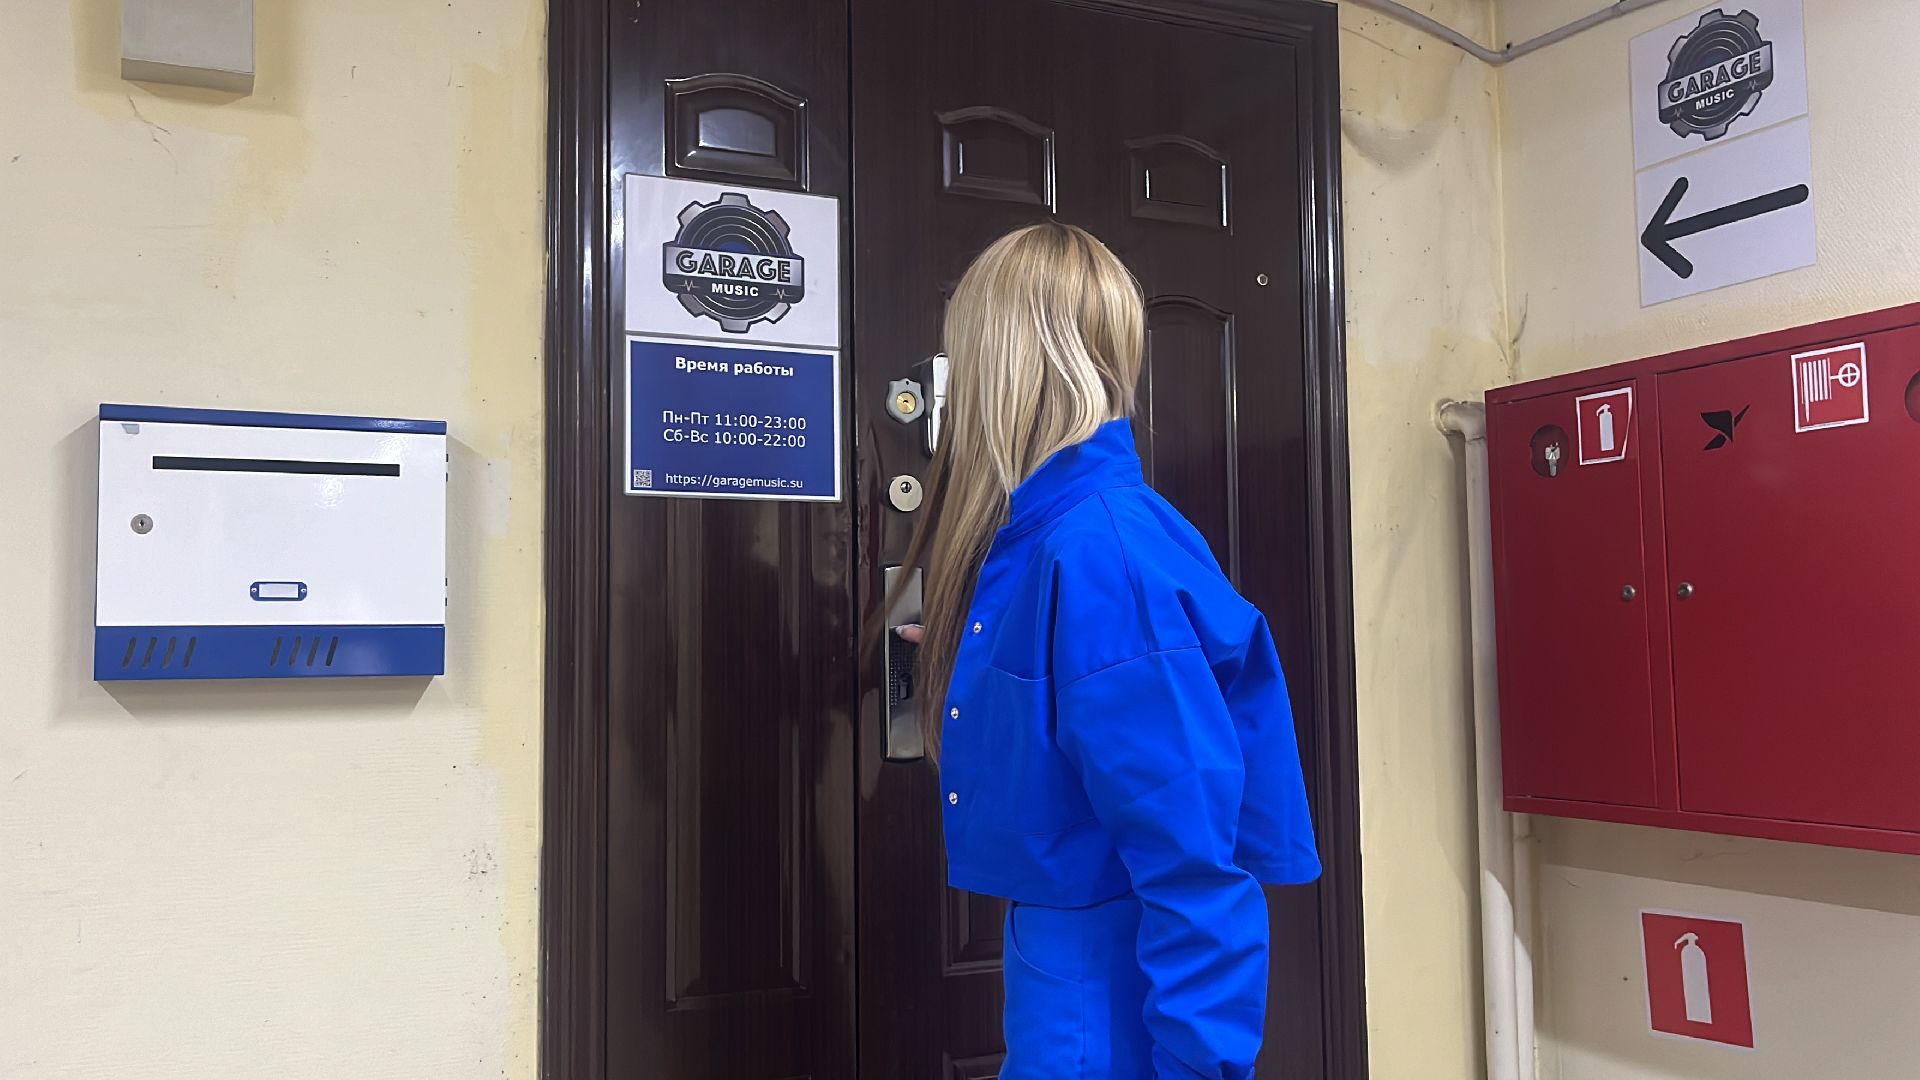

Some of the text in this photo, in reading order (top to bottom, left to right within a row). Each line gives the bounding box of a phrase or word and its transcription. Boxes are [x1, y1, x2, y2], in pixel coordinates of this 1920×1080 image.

[1667, 51, 1761, 103] GARAGE
[1695, 89, 1735, 110] MUSIC
[675, 250, 791, 282] GARAGE
[711, 283, 759, 297] MUSIC
[675, 357, 794, 377] Время работы
[663, 411, 806, 430] Пн-Пт 11:00-23:00
[663, 429, 806, 448] Сб-Вс 10:00-22:00
[665, 473, 803, 489] https://garagemusic.su
